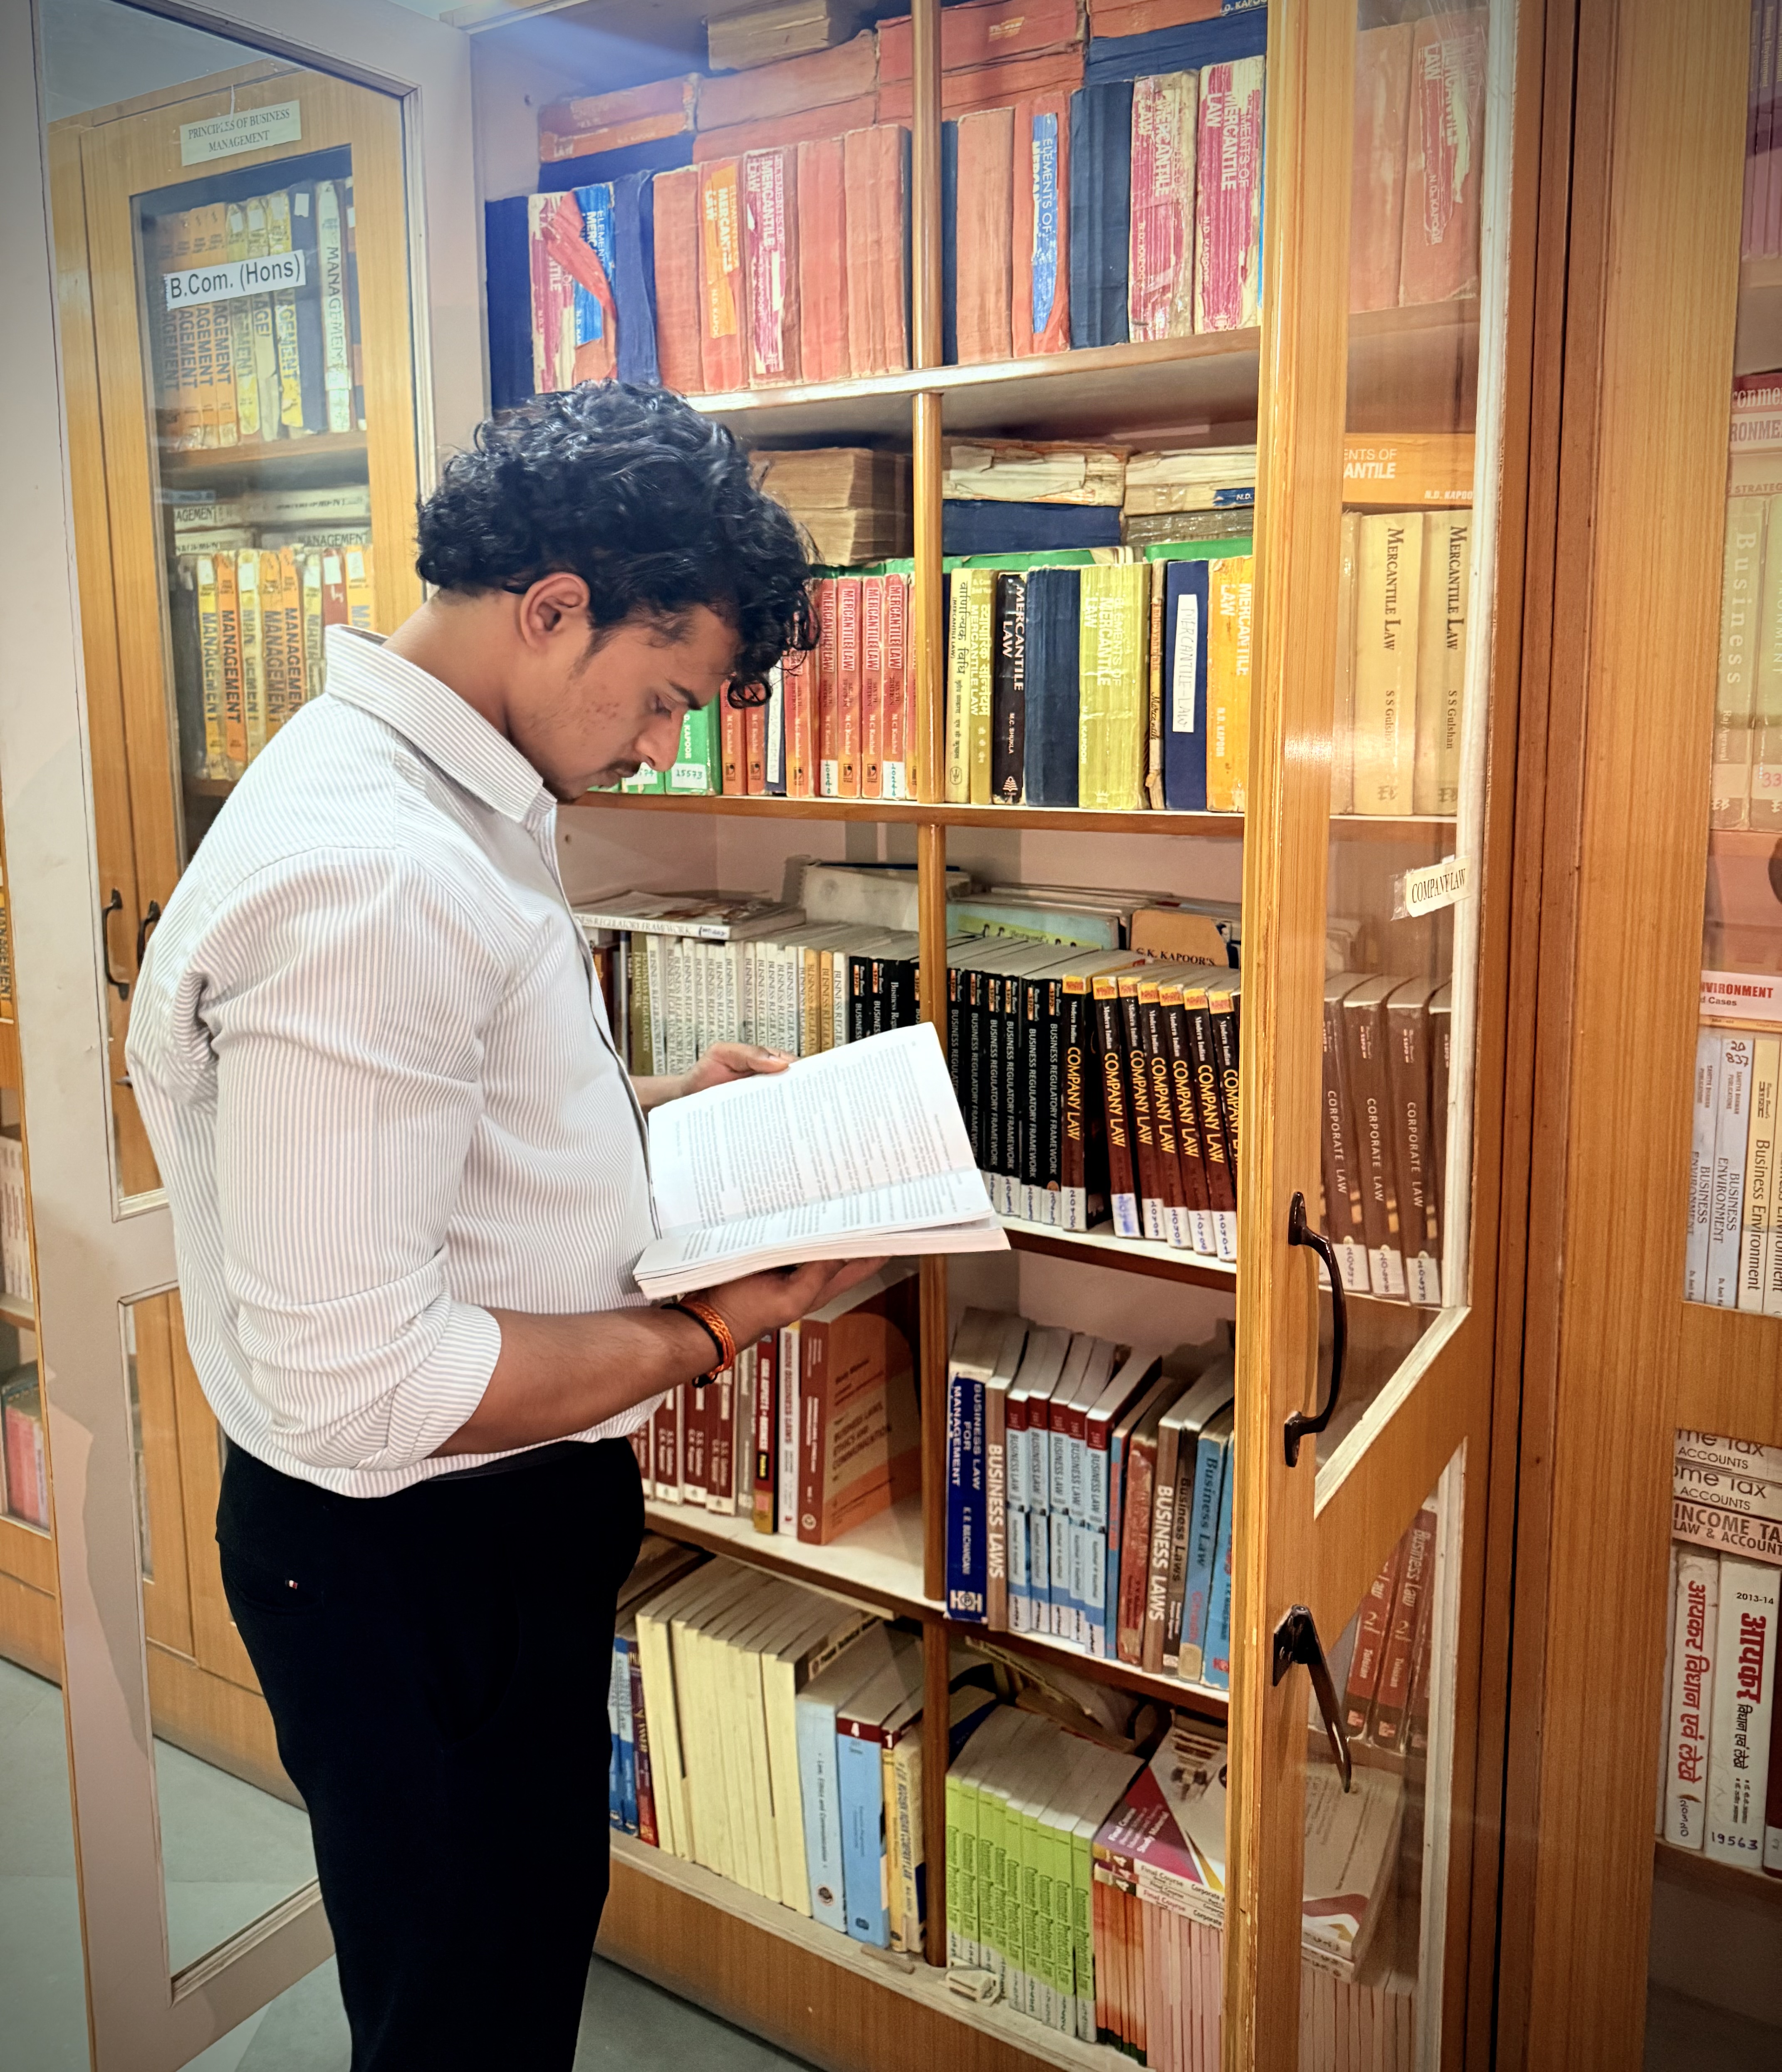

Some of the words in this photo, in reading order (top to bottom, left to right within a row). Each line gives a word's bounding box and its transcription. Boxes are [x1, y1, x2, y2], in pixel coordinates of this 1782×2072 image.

[188, 121, 235, 139] PRINCIPLES
[235, 117, 250, 129] OF
[250, 108, 290, 125] BUSINESS
[1203, 93, 1221, 127] LAW
[209, 130, 270, 152] MANAGEMENT
[1221, 92, 1240, 191] MERCANTILE
[1042, 139, 1052, 208] ELEMENTS
[761, 156, 775, 247] MERCANTILE
[1042, 213, 1052, 235] OF
[171, 269, 234, 300] B.Com.
[240, 253, 301, 292] (Hons)
[1379, 448, 1397, 460] OF
[1424, 491, 1443, 499] N.D.
[1385, 528, 1404, 615] MERCANTILE
[1448, 526, 1468, 615] MERCANTILE
[843, 589, 854, 647] MERCANTILE
[867, 587, 879, 647] MERCANTILE
[889, 585, 902, 646] MERCANTILE
[1111, 597, 1124, 661] ELEMENTS
[1727, 532, 1757, 684] Business
[970, 604, 979, 686] MERCANTILE
[1003, 621, 1013, 657] LAW
[1014, 587, 1025, 691] MERCANTILE
[1097, 597, 1113, 686] MERCANTILE
[1237, 584, 1252, 676] MERCANTILE
[1384, 619, 1401, 651] LAW
[1446, 619, 1465, 651] LAW
[222, 610, 241, 723] MANAGEMENT
[284, 608, 303, 710] MANAGEMEN
[823, 649, 834, 673] LAW
[843, 649, 854, 671] LAW
[867, 648, 879, 671] LAW
[889, 646, 902, 669] LAW
[1112, 662, 1121, 687] OF
[970, 688, 979, 716] LAW
[1217, 708, 1225, 729] N.D.
[1216, 731, 1225, 757] KAPOOR
[1446, 708, 1456, 750] Gulshan
[1412, 874, 1450, 903] COMPANY
[1450, 869, 1465, 891] LAW
[1708, 996, 1737, 1006] Cases
[1007, 1021, 1015, 1061] BUSINESS
[1007, 1062, 1015, 1115] REGULATORY
[1067, 1047, 1081, 1109] COMPANY
[1105, 1053, 1123, 1115] COMPANY
[1130, 1050, 1149, 1113] COMPANY
[1151, 1057, 1171, 1121] COMPANY
[1173, 1060, 1195, 1124] COMPANY
[1198, 1065, 1220, 1130] COMPANY
[1007, 1116, 1015, 1170] FRAMEWORK
[1067, 1113, 1080, 1141] LAW
[1110, 1119, 1126, 1147] LAW
[1137, 1117, 1152, 1145] LAW
[1159, 1125, 1175, 1154] LAW
[1181, 1129, 1199, 1157] LAW
[1327, 1090, 1344, 1161] CORPORATE
[1336, 1169, 1347, 1194] LAW
[1367, 1098, 1381, 1167] CORPORATE
[1407, 1102, 1421, 1173] CORPORATE
[1207, 1134, 1225, 1163] LAW
[1373, 1176, 1384, 1202] LAW
[1752, 1139, 1771, 1201] Business
[1412, 1181, 1423, 1207] LAW
[1697, 1166, 1710, 1224] BUSINESS
[1713, 1158, 1728, 1244] ENVIRONMENT
[1726, 1173, 1740, 1232] BUSINESS
[1747, 1205, 1766, 1291] Environment
[952, 1386, 963, 1487] MANAGEMENT
[963, 1421, 973, 1451] FOR
[1009, 1433, 1020, 1473] BUSINESS
[1031, 1431, 1041, 1473] BUSINESS
[1054, 1436, 1064, 1476] BUSINESS
[1071, 1442, 1082, 1484] BUSINESS
[1678, 1447, 1748, 1470] ACCOUNTS
[989, 1444, 1004, 1527] BUSINESS
[1200, 1458, 1218, 1533] Business
[1681, 1486, 1750, 1510] ACCOUNTS
[1151, 1485, 1174, 1568] BUSINESS
[1176, 1478, 1190, 1543] Business
[1673, 1520, 1700, 1535] LAW
[1706, 1528, 1715, 1539] &
[1674, 1503, 1750, 1535] INCOME
[988, 1534, 1004, 1578] LAWS
[1173, 1545, 1185, 1582] Laws
[1198, 1534, 1210, 1567] Law
[1407, 1529, 1431, 1580] Business
[1149, 1576, 1167, 1621] LAWS
[1403, 1582, 1421, 1607] Law
[1736, 1592, 1774, 1605] 2013-14
[1685, 1580, 1706, 1652] आयकर
[1736, 1612, 1767, 1704] आयकर
[1683, 1654, 1710, 1710] विधान
[1681, 1713, 1705, 1741] एवं
[1735, 1704, 1753, 1732] विधान
[1712, 1832, 1758, 1850] 19563
[1141, 1865, 1159, 1875] Final
[1191, 1884, 1220, 1900] Corporate
[1194, 1910, 1222, 1926] Corporate
